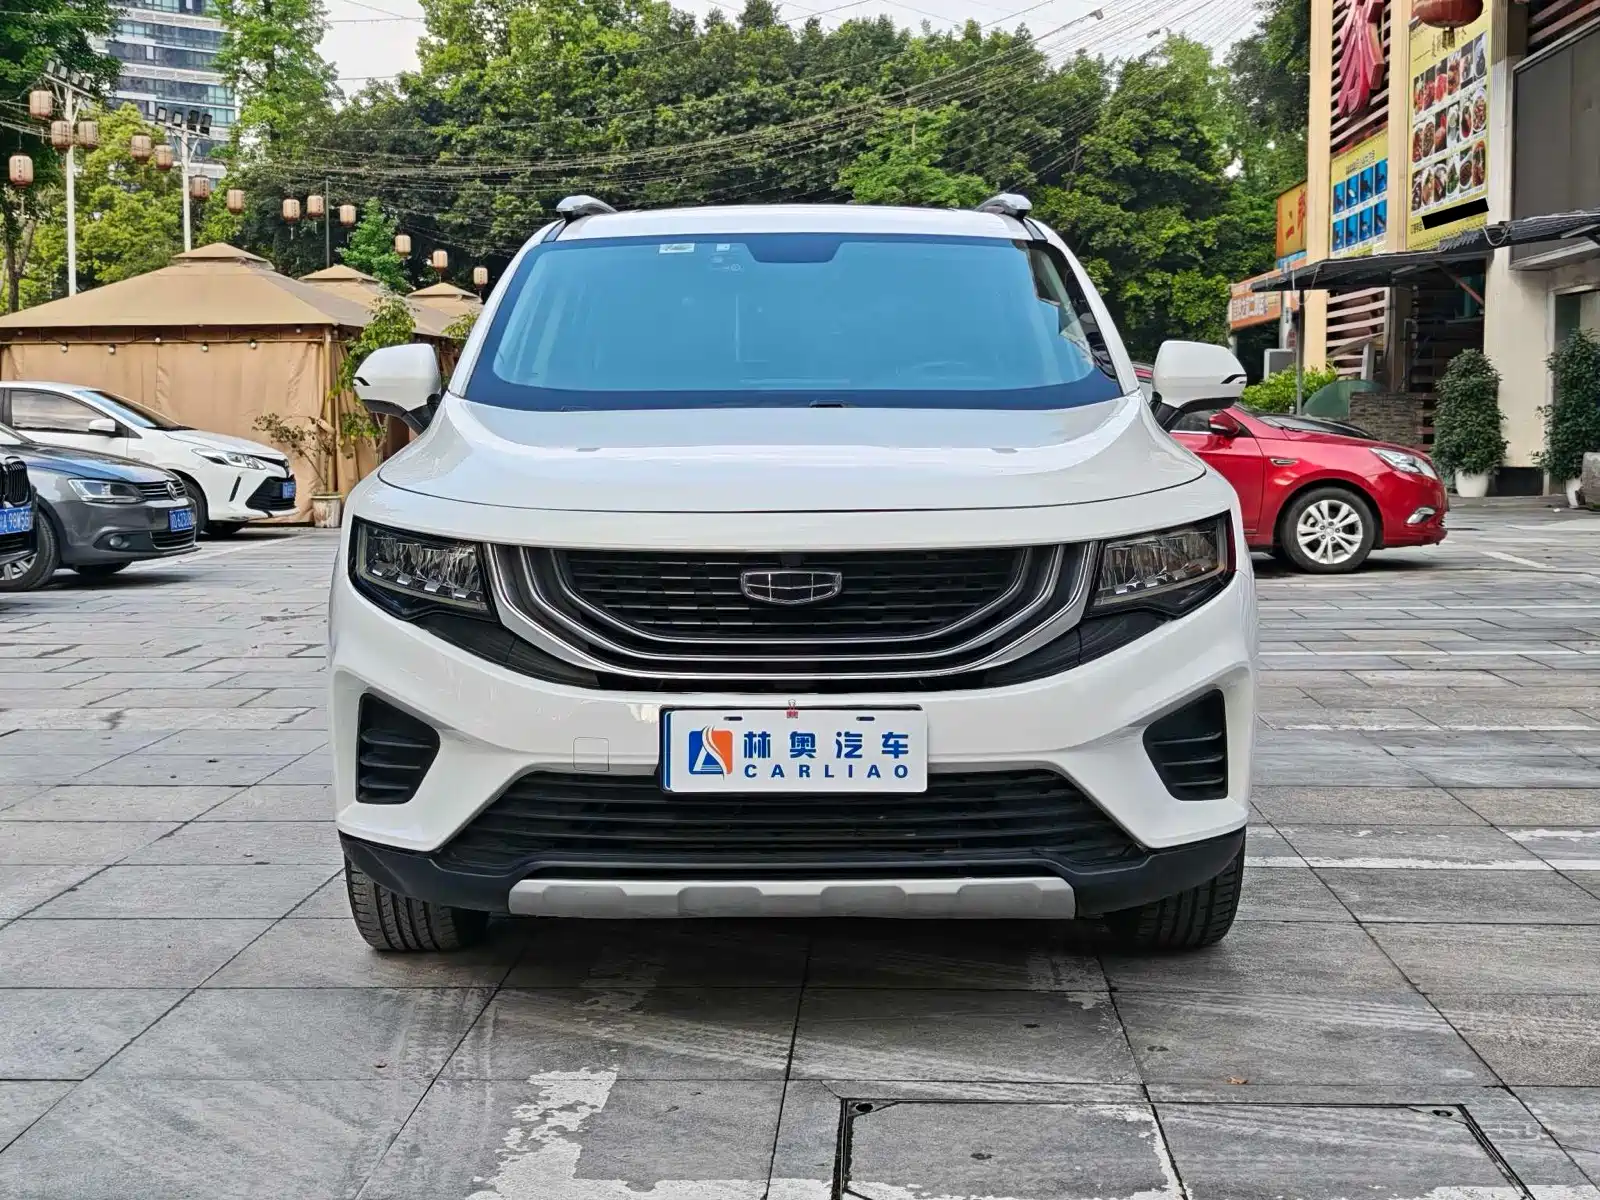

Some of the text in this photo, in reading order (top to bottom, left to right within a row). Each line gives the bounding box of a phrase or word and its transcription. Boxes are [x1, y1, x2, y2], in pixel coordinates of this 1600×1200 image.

[743, 731, 909, 759] 林奥汽车
[744, 764, 908, 778] CARLIAO
